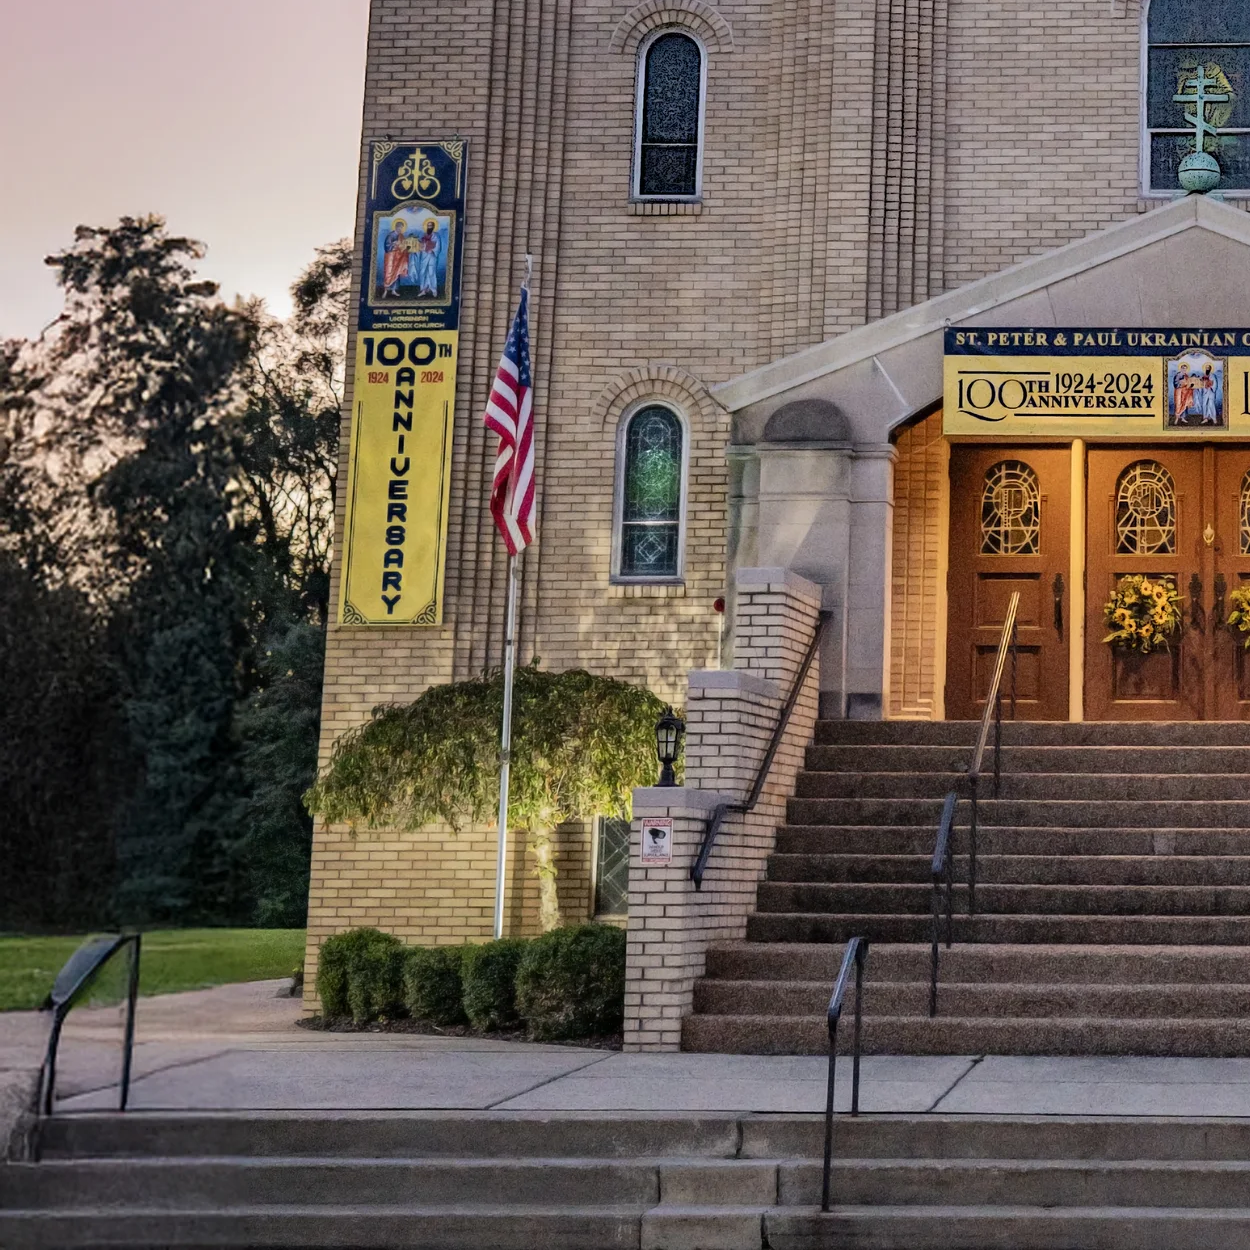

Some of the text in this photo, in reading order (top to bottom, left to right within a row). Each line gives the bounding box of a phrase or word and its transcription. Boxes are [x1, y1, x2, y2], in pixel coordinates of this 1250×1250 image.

[956, 333, 981, 346] ST.
[988, 332, 1049, 347] PETER
[1053, 332, 1068, 347] &
[1073, 333, 1122, 346] PAUL
[1127, 332, 1237, 347] UKRAINIAN
[367, 371, 444, 384] 1924 2024
[1055, 372, 1154, 394] 1924-2024
[1025, 395, 1155, 409] ANNIVERSARY
[381, 366, 416, 615] ANNIVERSARY
